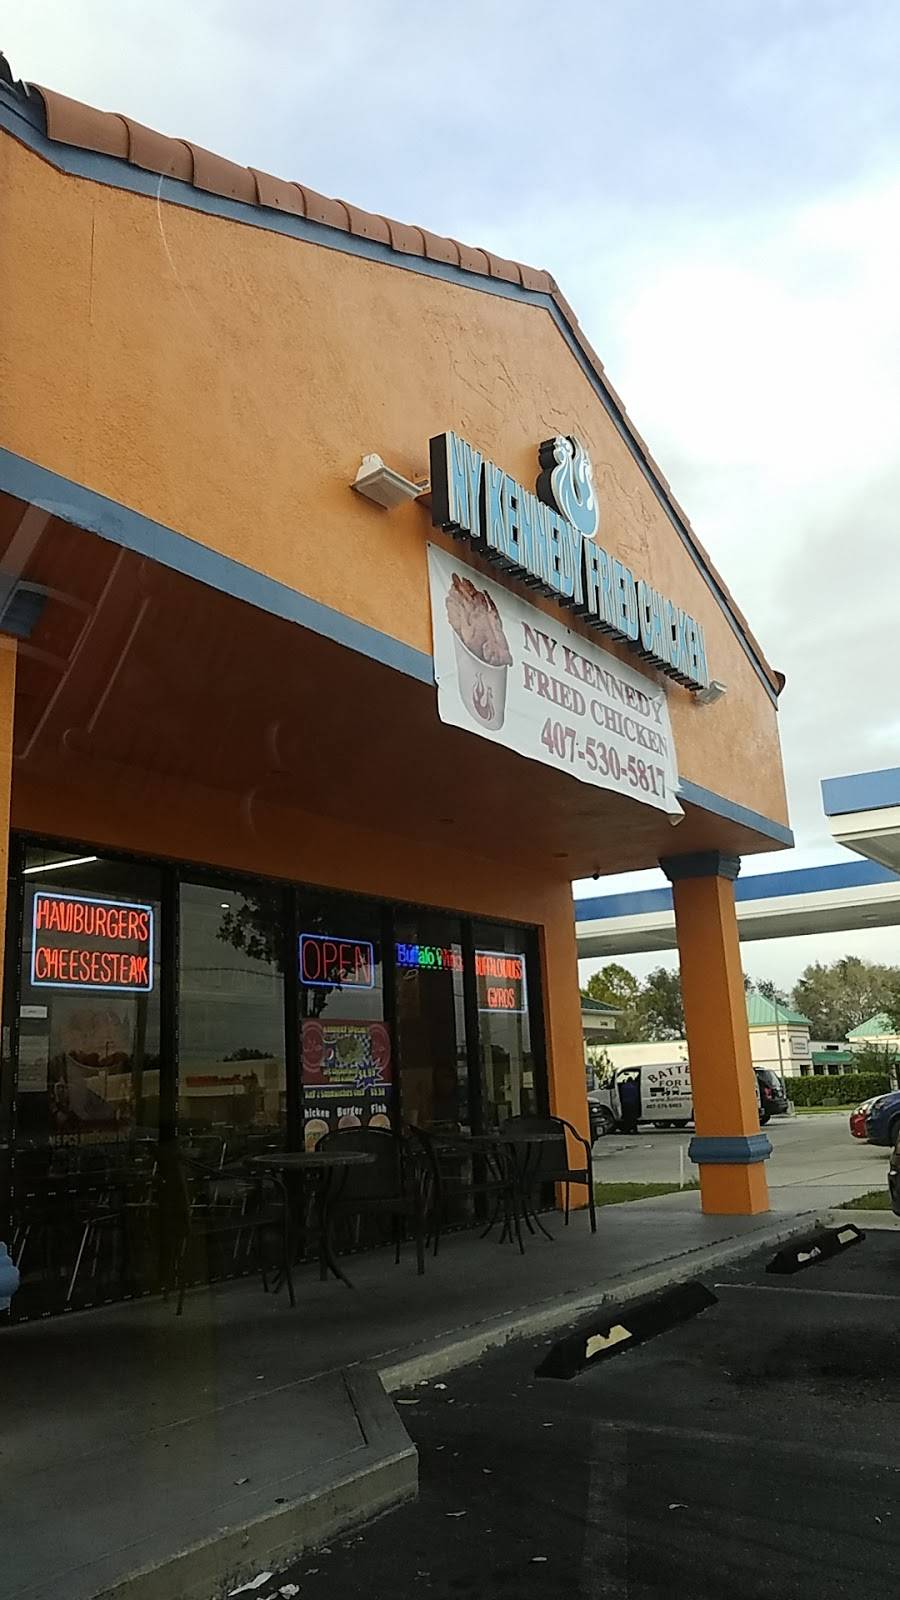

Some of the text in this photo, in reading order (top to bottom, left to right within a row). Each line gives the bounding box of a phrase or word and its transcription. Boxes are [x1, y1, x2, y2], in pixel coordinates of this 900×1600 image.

[446, 430, 709, 688] NY KENNEDY FRIED CHICKEN
[521, 621, 664, 725] NY KENNEDY
[522, 661, 667, 758] FRIED CHICKEN
[541, 718, 666, 800] 407-530-5817
[36, 899, 149, 941] HAMBURGERS
[35, 946, 148, 985] CHEESESTEAK
[303, 940, 371, 983] OPEN
[648, 1065, 691, 1083] BATTE
[659, 1079, 681, 1087] FOR
[304, 1103, 387, 1118] hicken Burger Fish
